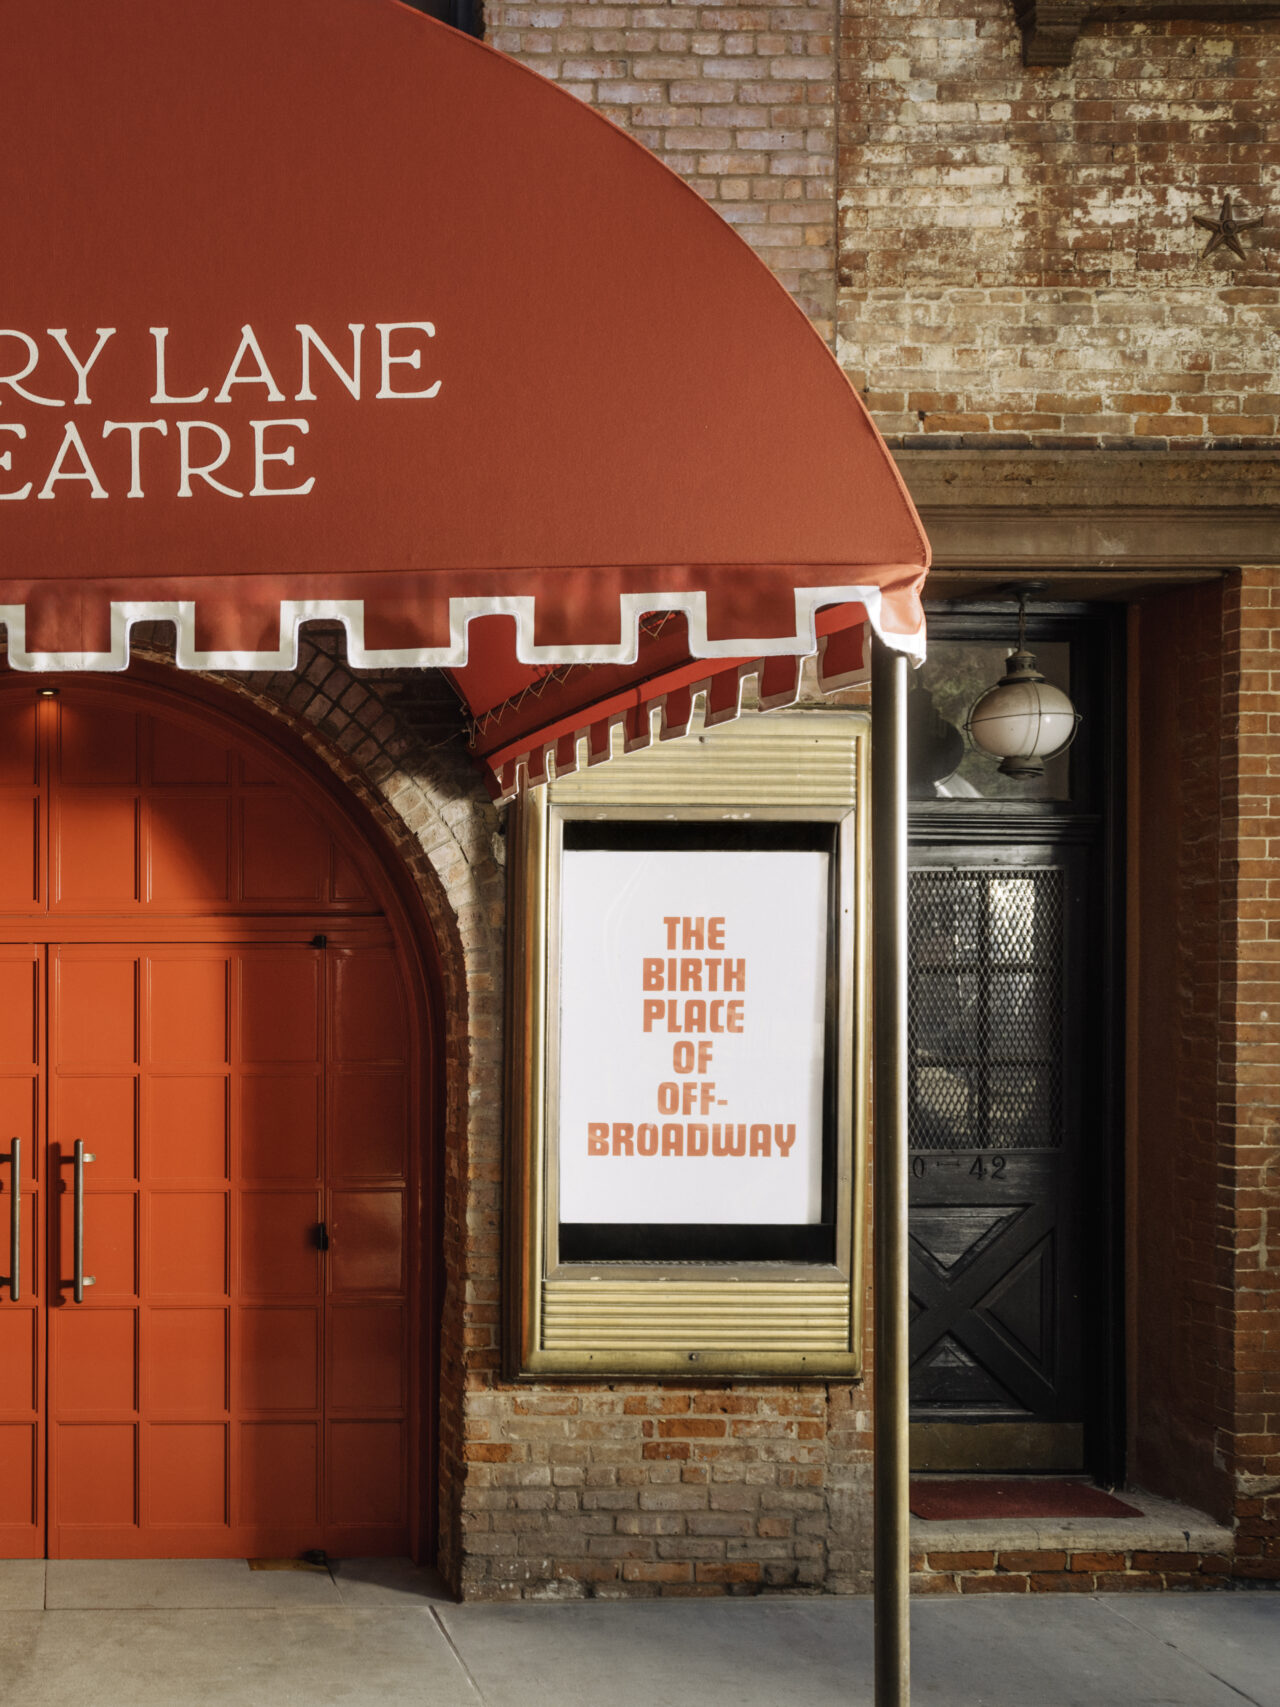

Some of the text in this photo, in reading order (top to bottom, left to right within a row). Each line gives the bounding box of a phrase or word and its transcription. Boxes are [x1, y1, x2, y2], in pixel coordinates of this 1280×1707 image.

[149, 321, 443, 404] LANE
[663, 916, 726, 951] THE
[642, 957, 746, 993] BIRTH
[642, 998, 745, 1034] PLACE
[672, 1040, 713, 1075] OF
[657, 1081, 729, 1116] OFF-
[587, 1122, 797, 1158] BROADWAY
[969, 1155, 1007, 1181] 42
